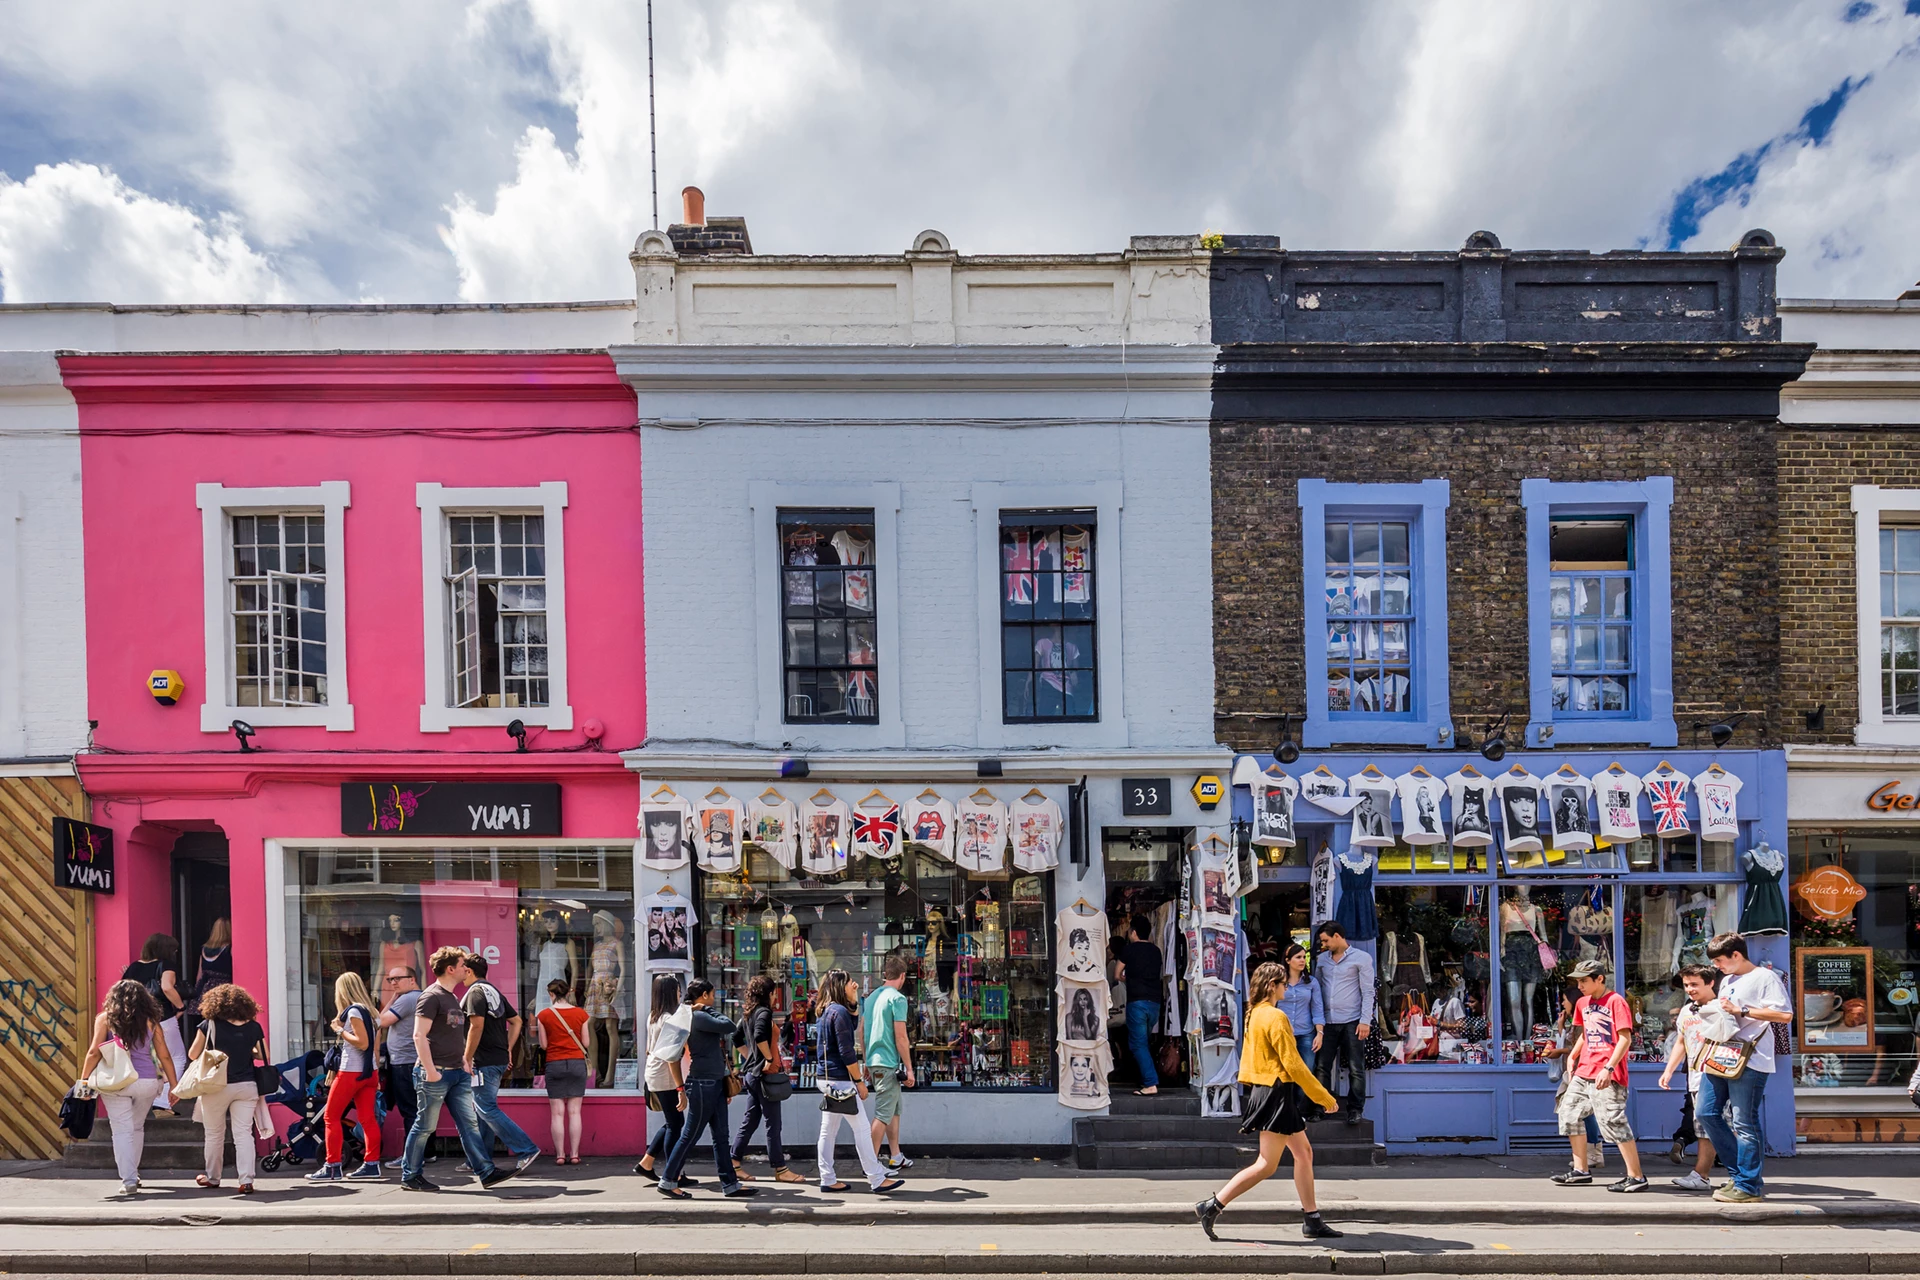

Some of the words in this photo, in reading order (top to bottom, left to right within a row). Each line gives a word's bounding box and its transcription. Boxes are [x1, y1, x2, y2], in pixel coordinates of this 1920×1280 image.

[152, 679, 168, 687] ADT
[1201, 784, 1217, 794] ADT
[1133, 787, 1158, 806] 33
[1867, 780, 1920, 811] Ge
[1261, 812, 1288, 822] FUCK
[1800, 883, 1839, 895] Gelato
[1843, 886, 1863, 895] Mio
